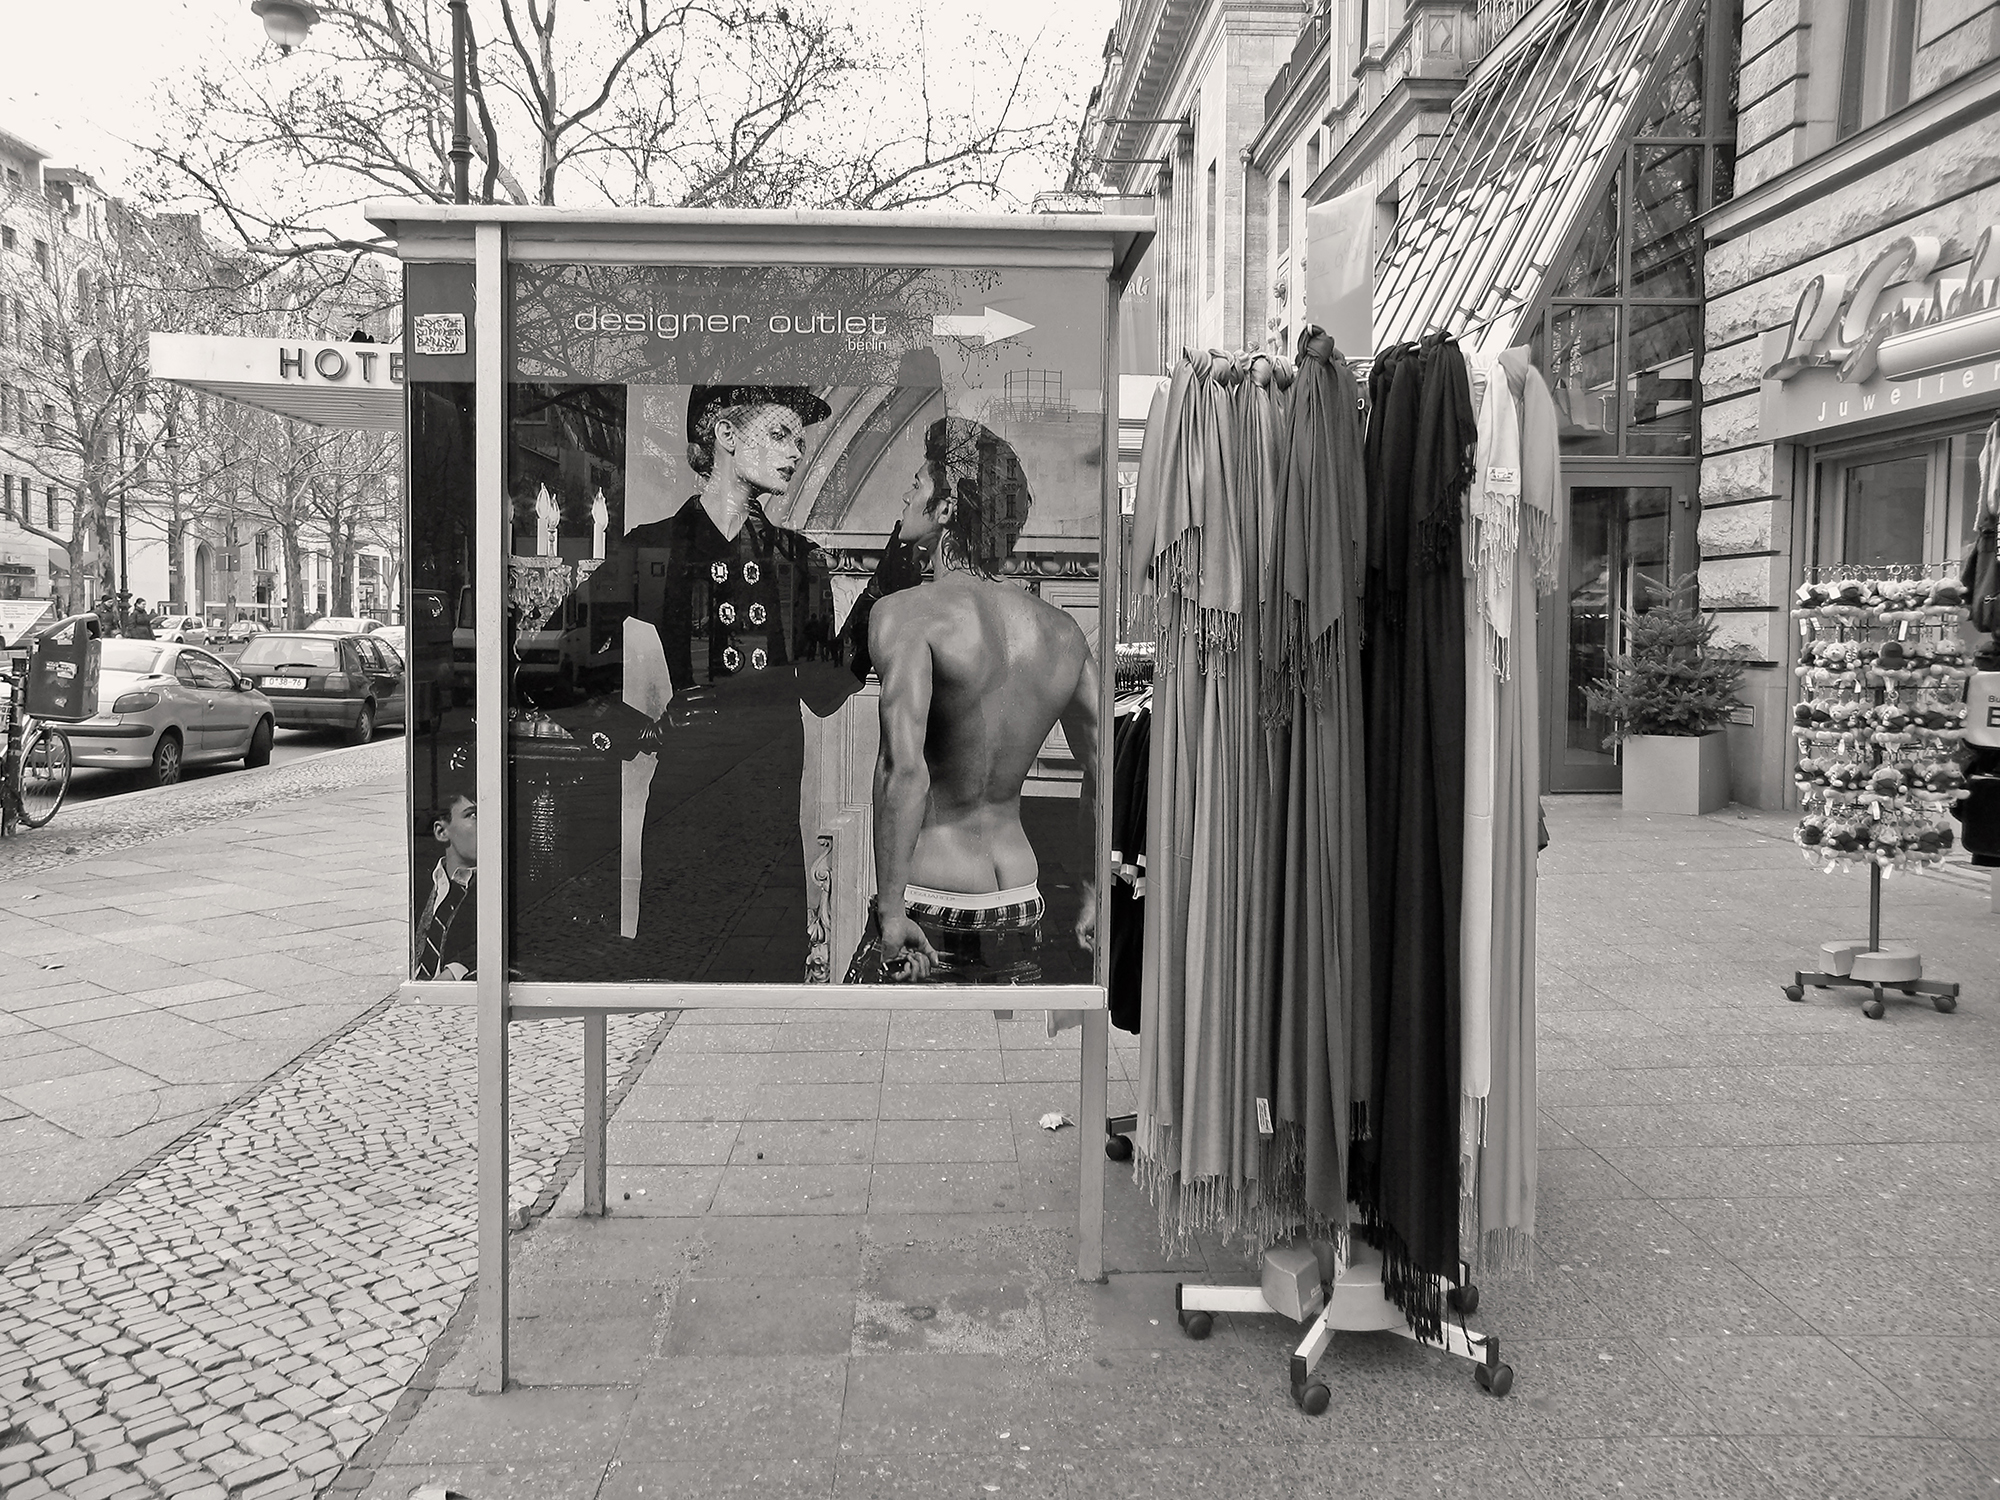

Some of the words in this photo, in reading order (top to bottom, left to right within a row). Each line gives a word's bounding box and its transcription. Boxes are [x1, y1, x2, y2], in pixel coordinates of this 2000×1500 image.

[575, 306, 750, 339] designer
[769, 310, 886, 334] outlet
[846, 338, 887, 351] berlin
